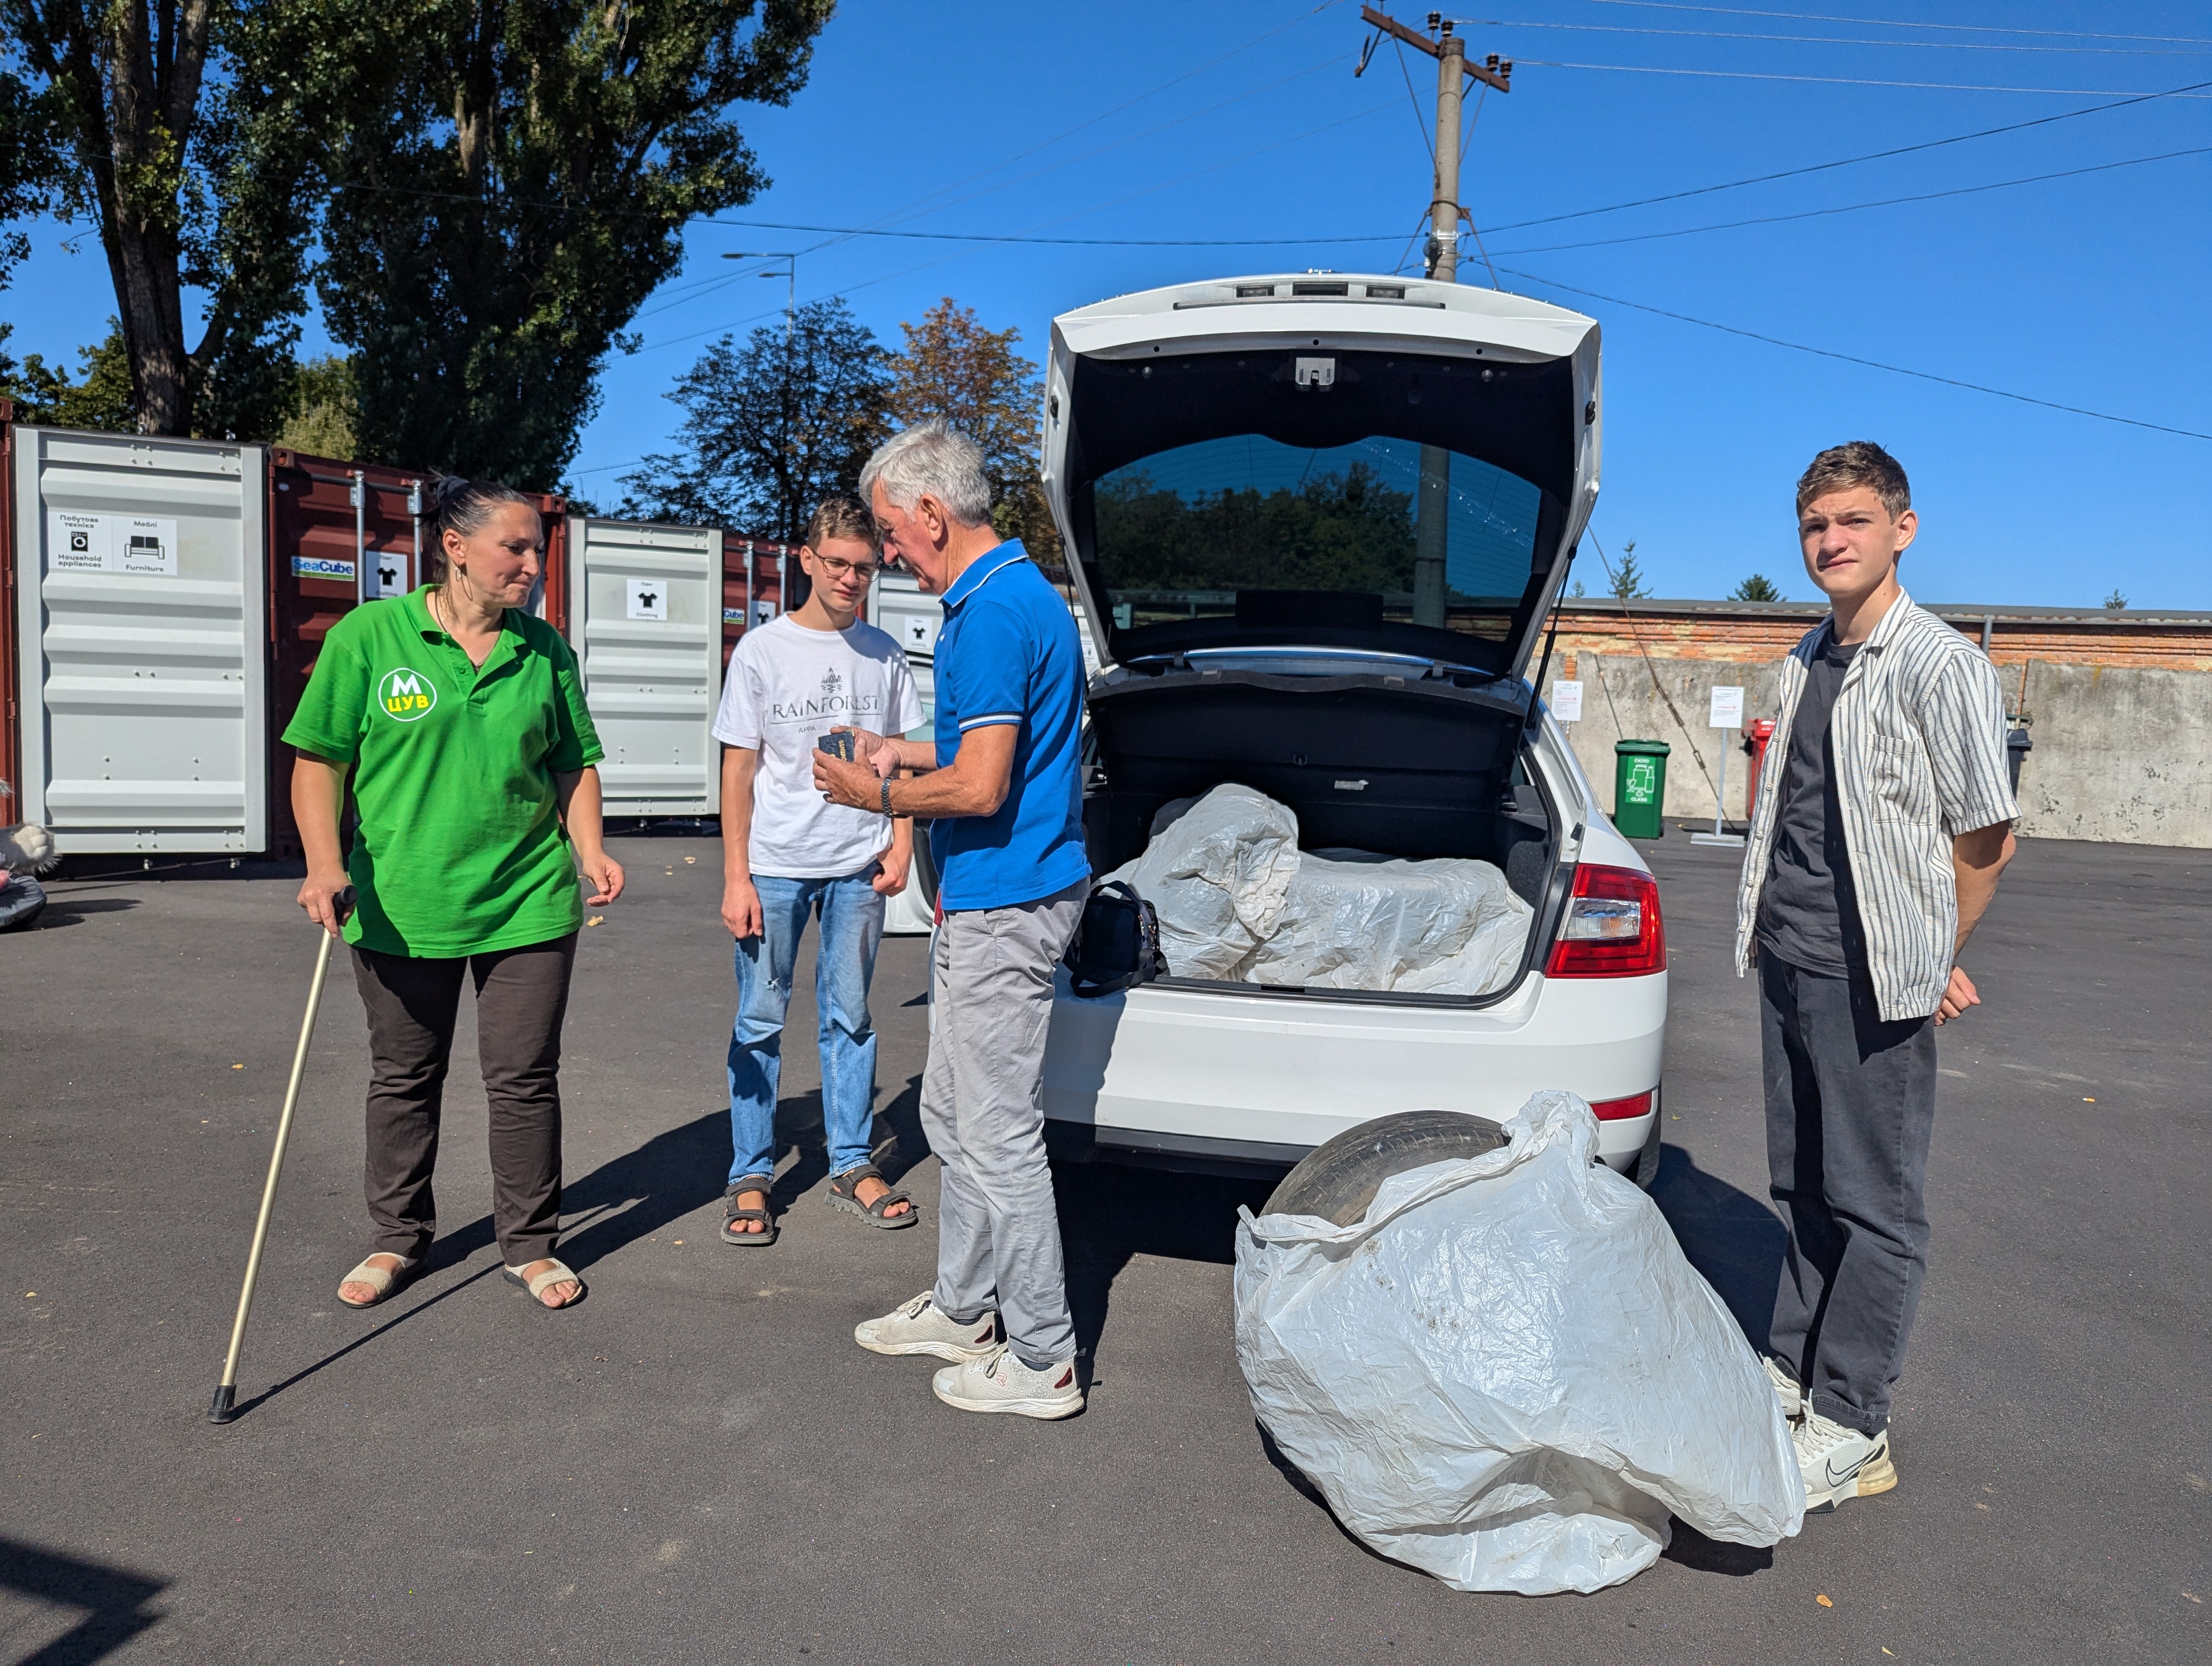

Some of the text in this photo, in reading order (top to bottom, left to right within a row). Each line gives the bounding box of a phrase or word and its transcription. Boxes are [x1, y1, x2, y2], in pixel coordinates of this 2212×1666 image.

[60, 515, 99, 523] Побутова
[58, 554, 102, 562] Household
[126, 564, 164, 572] Furniture
[294, 558, 353, 574] SeaCube
[724, 610, 744, 619] Cube
[391, 674, 422, 697] М
[388, 695, 429, 712] ЦУВ
[773, 695, 881, 719] RAINFOREST
